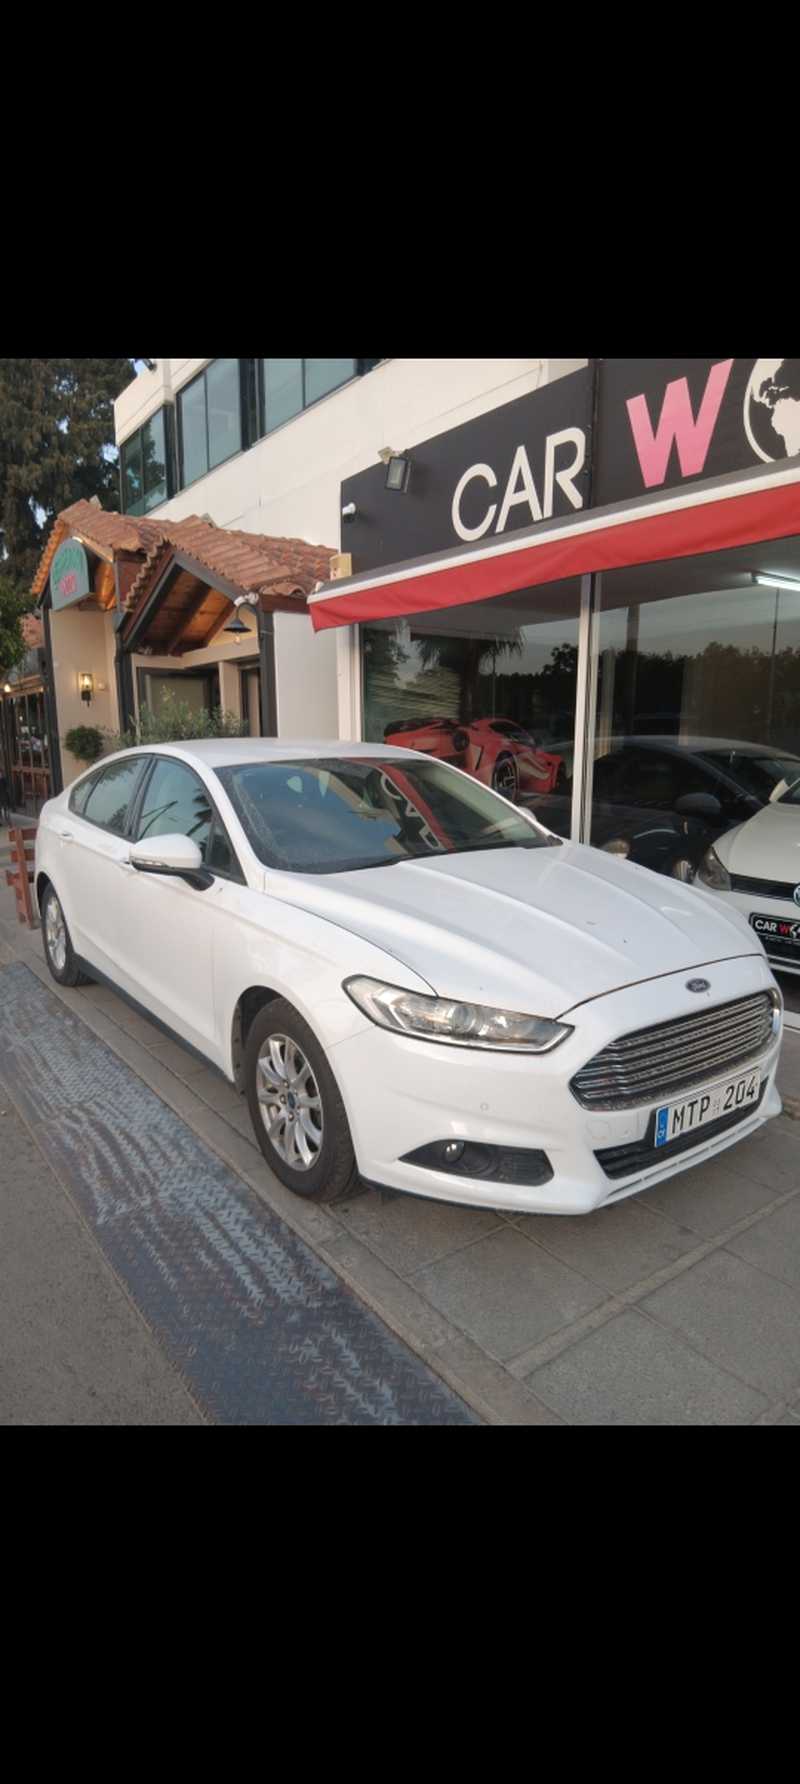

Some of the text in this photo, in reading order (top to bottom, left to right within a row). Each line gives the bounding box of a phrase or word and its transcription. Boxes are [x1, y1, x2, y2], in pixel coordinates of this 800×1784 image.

[451, 427, 586, 541] CAR
[755, 920, 777, 933] CAR
[672, 1075, 756, 1134] MTP 204
